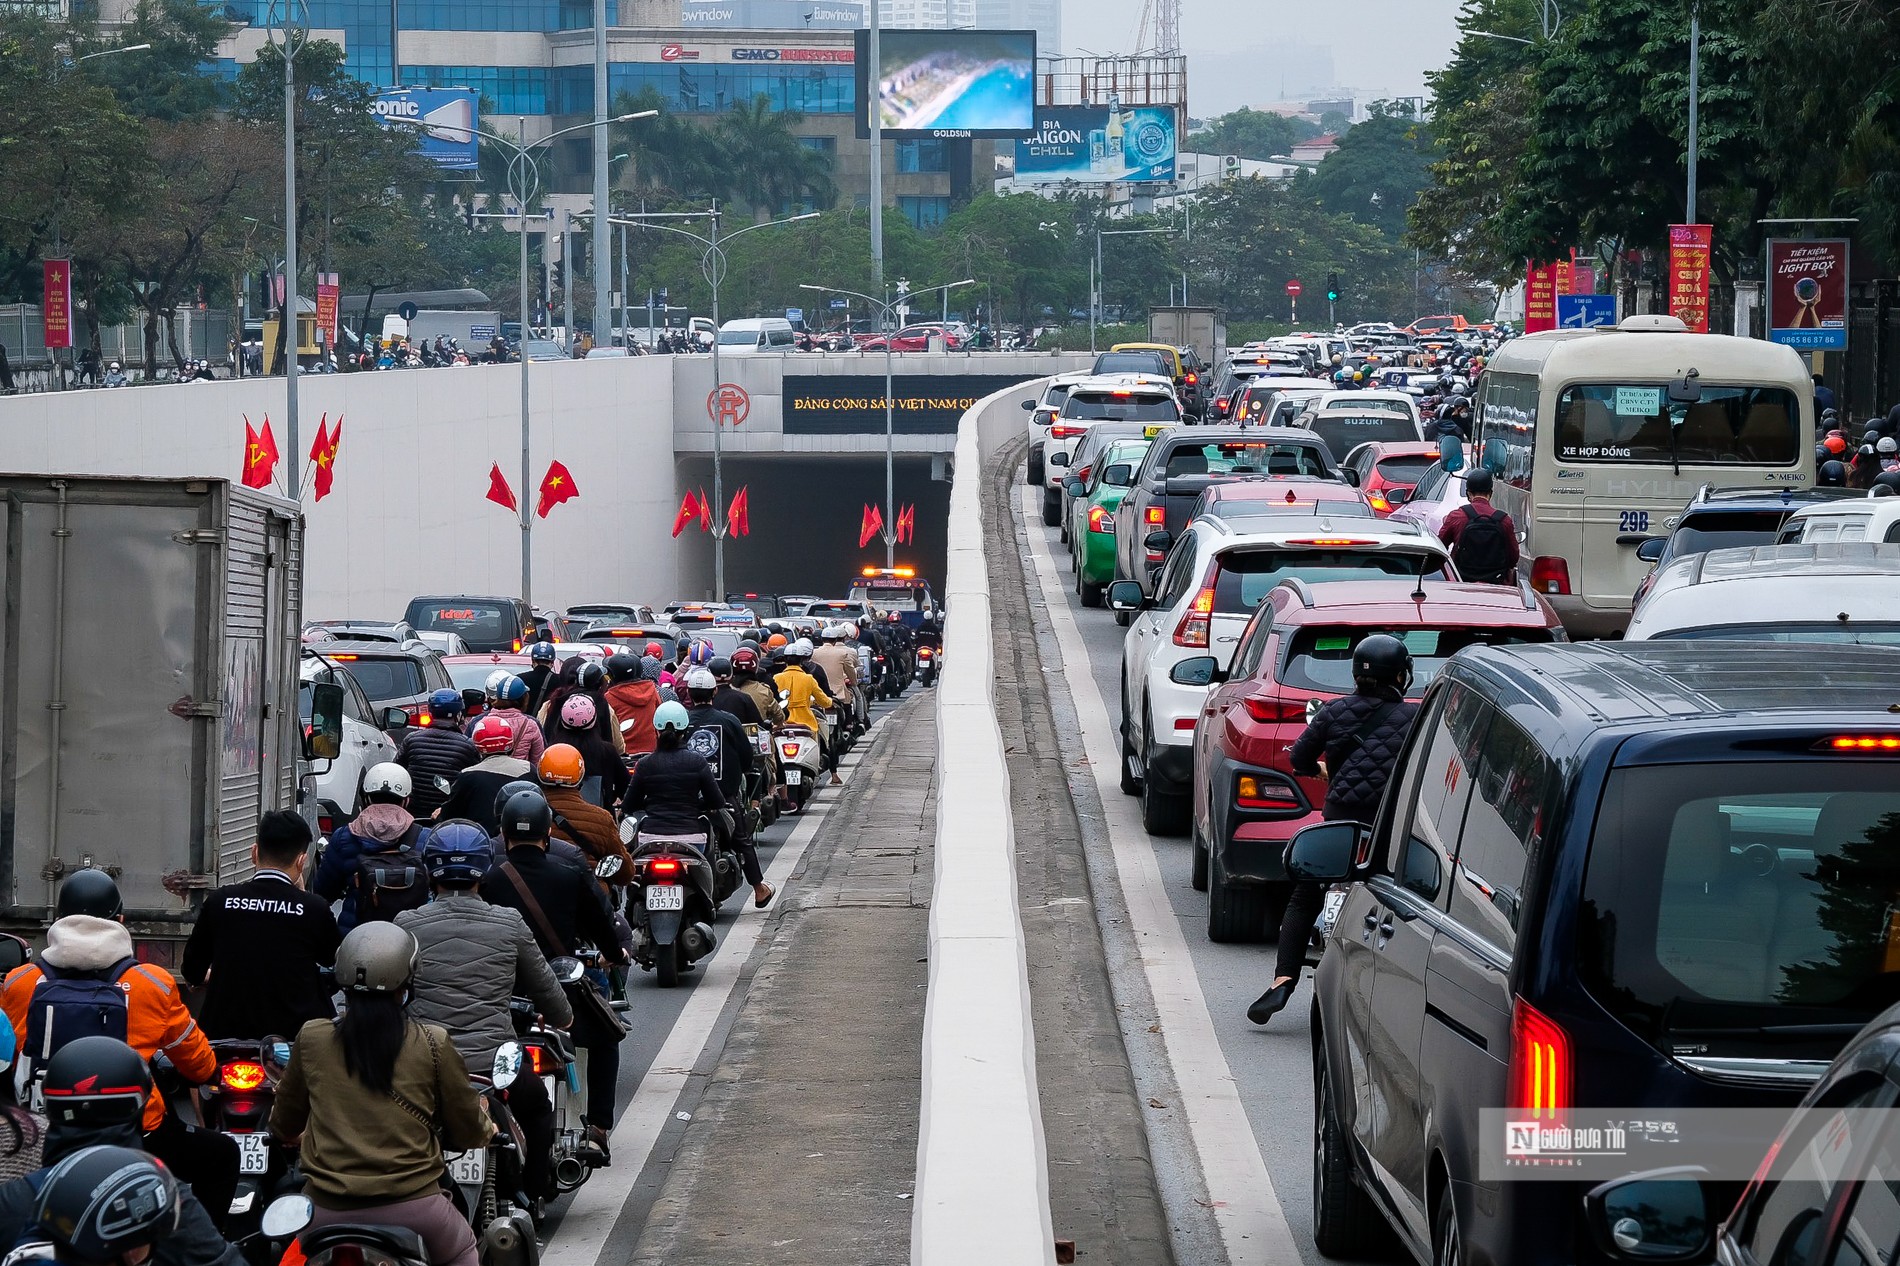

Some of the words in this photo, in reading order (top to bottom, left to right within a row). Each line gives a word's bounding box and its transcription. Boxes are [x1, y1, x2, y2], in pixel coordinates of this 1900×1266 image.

[814, 7, 859, 22] Eurowindow
[732, 49, 779, 60] GMO
[1042, 120, 1061, 130] BIA
[933, 129, 971, 138] GOLDSUN
[1030, 146, 1075, 156] CHILL
[1791, 247, 1807, 257] TIẾT
[1807, 246, 1828, 257] KIỆM
[1778, 262, 1811, 274] LIGHT
[1811, 260, 1836, 271] BOX
[1781, 336, 1801, 344] 0865
[1813, 336, 1823, 344] 87
[1824, 336, 1835, 344] 86
[794, 396, 831, 410] ĐẢNG
[832, 397, 868, 411] CỘNG
[870, 395, 895, 410] SẢN
[898, 397, 926, 411] VIỆT
[927, 398, 957, 410] NAM
[1563, 446, 1576, 455] XE
[1579, 447, 1599, 457] HỢP
[1601, 445, 1631, 457] ĐỒNG
[1778, 472, 1806, 482] MEIKO
[1619, 511, 1649, 532] 29B
[652, 887, 677, 898] 29-T1
[225, 897, 304, 916] ESSENTIALS
[649, 897, 681, 909] 835.79
